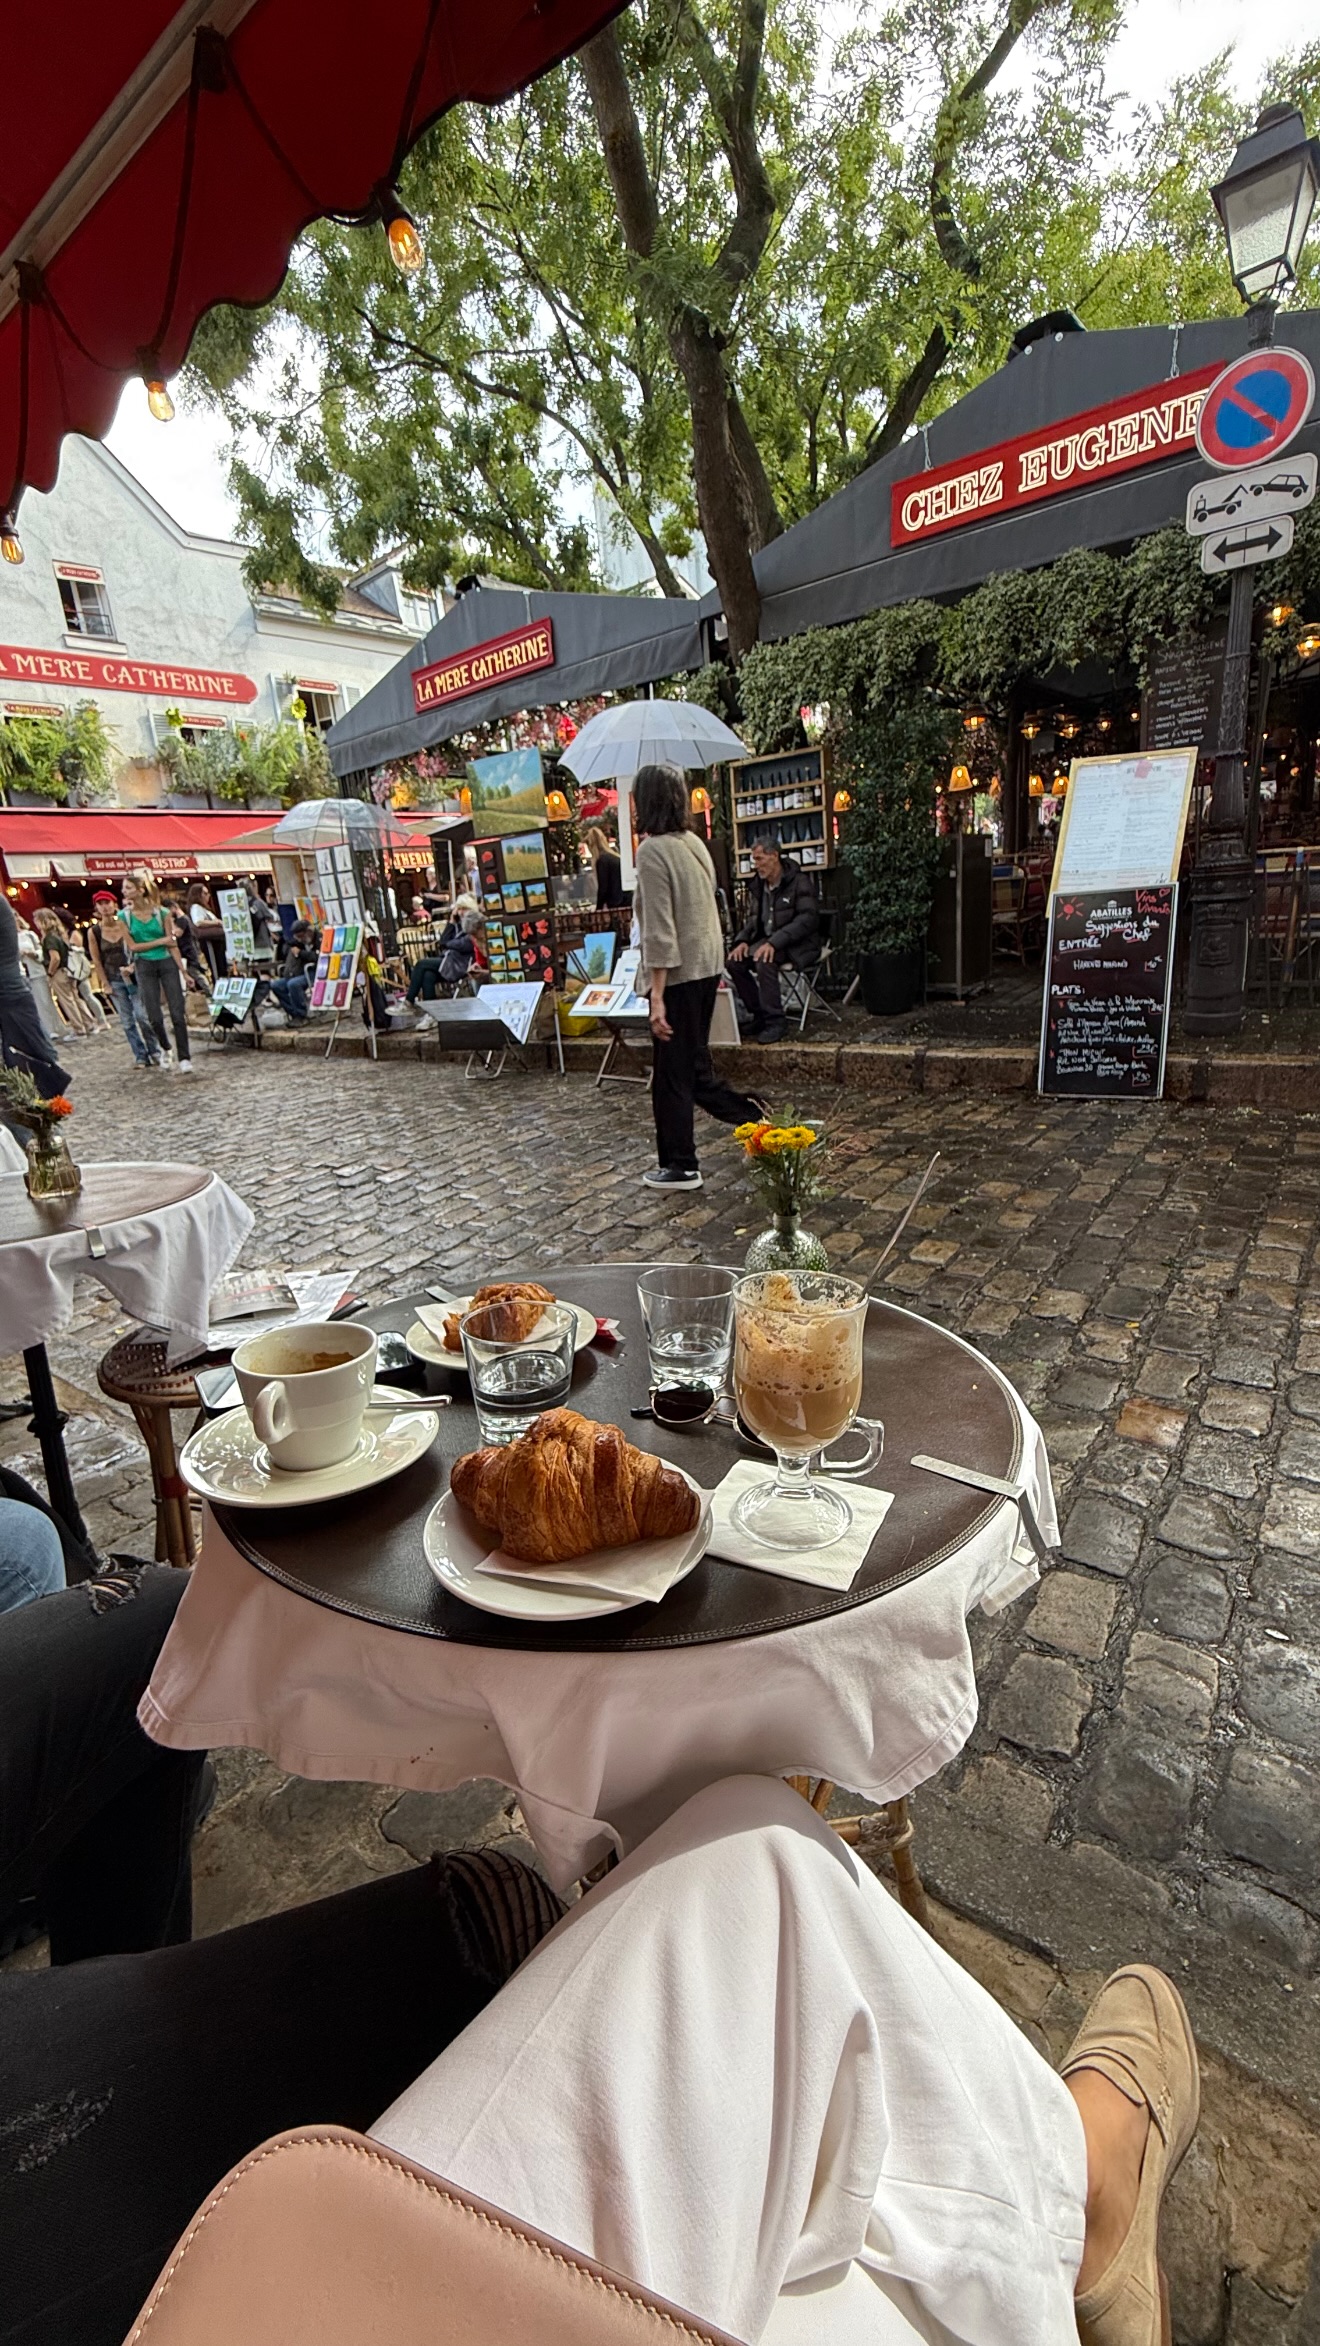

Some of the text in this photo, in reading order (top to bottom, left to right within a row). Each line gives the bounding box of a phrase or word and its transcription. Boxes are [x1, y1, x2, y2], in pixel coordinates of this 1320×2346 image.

[901, 387, 1209, 532] CHEZ EUGENE
[11, 652, 94, 681] MERE
[102, 664, 238, 696] CATHERINE
[416, 632, 549, 703] LA MERE CATHERINE
[1090, 906, 1133, 919] ABATILLES
